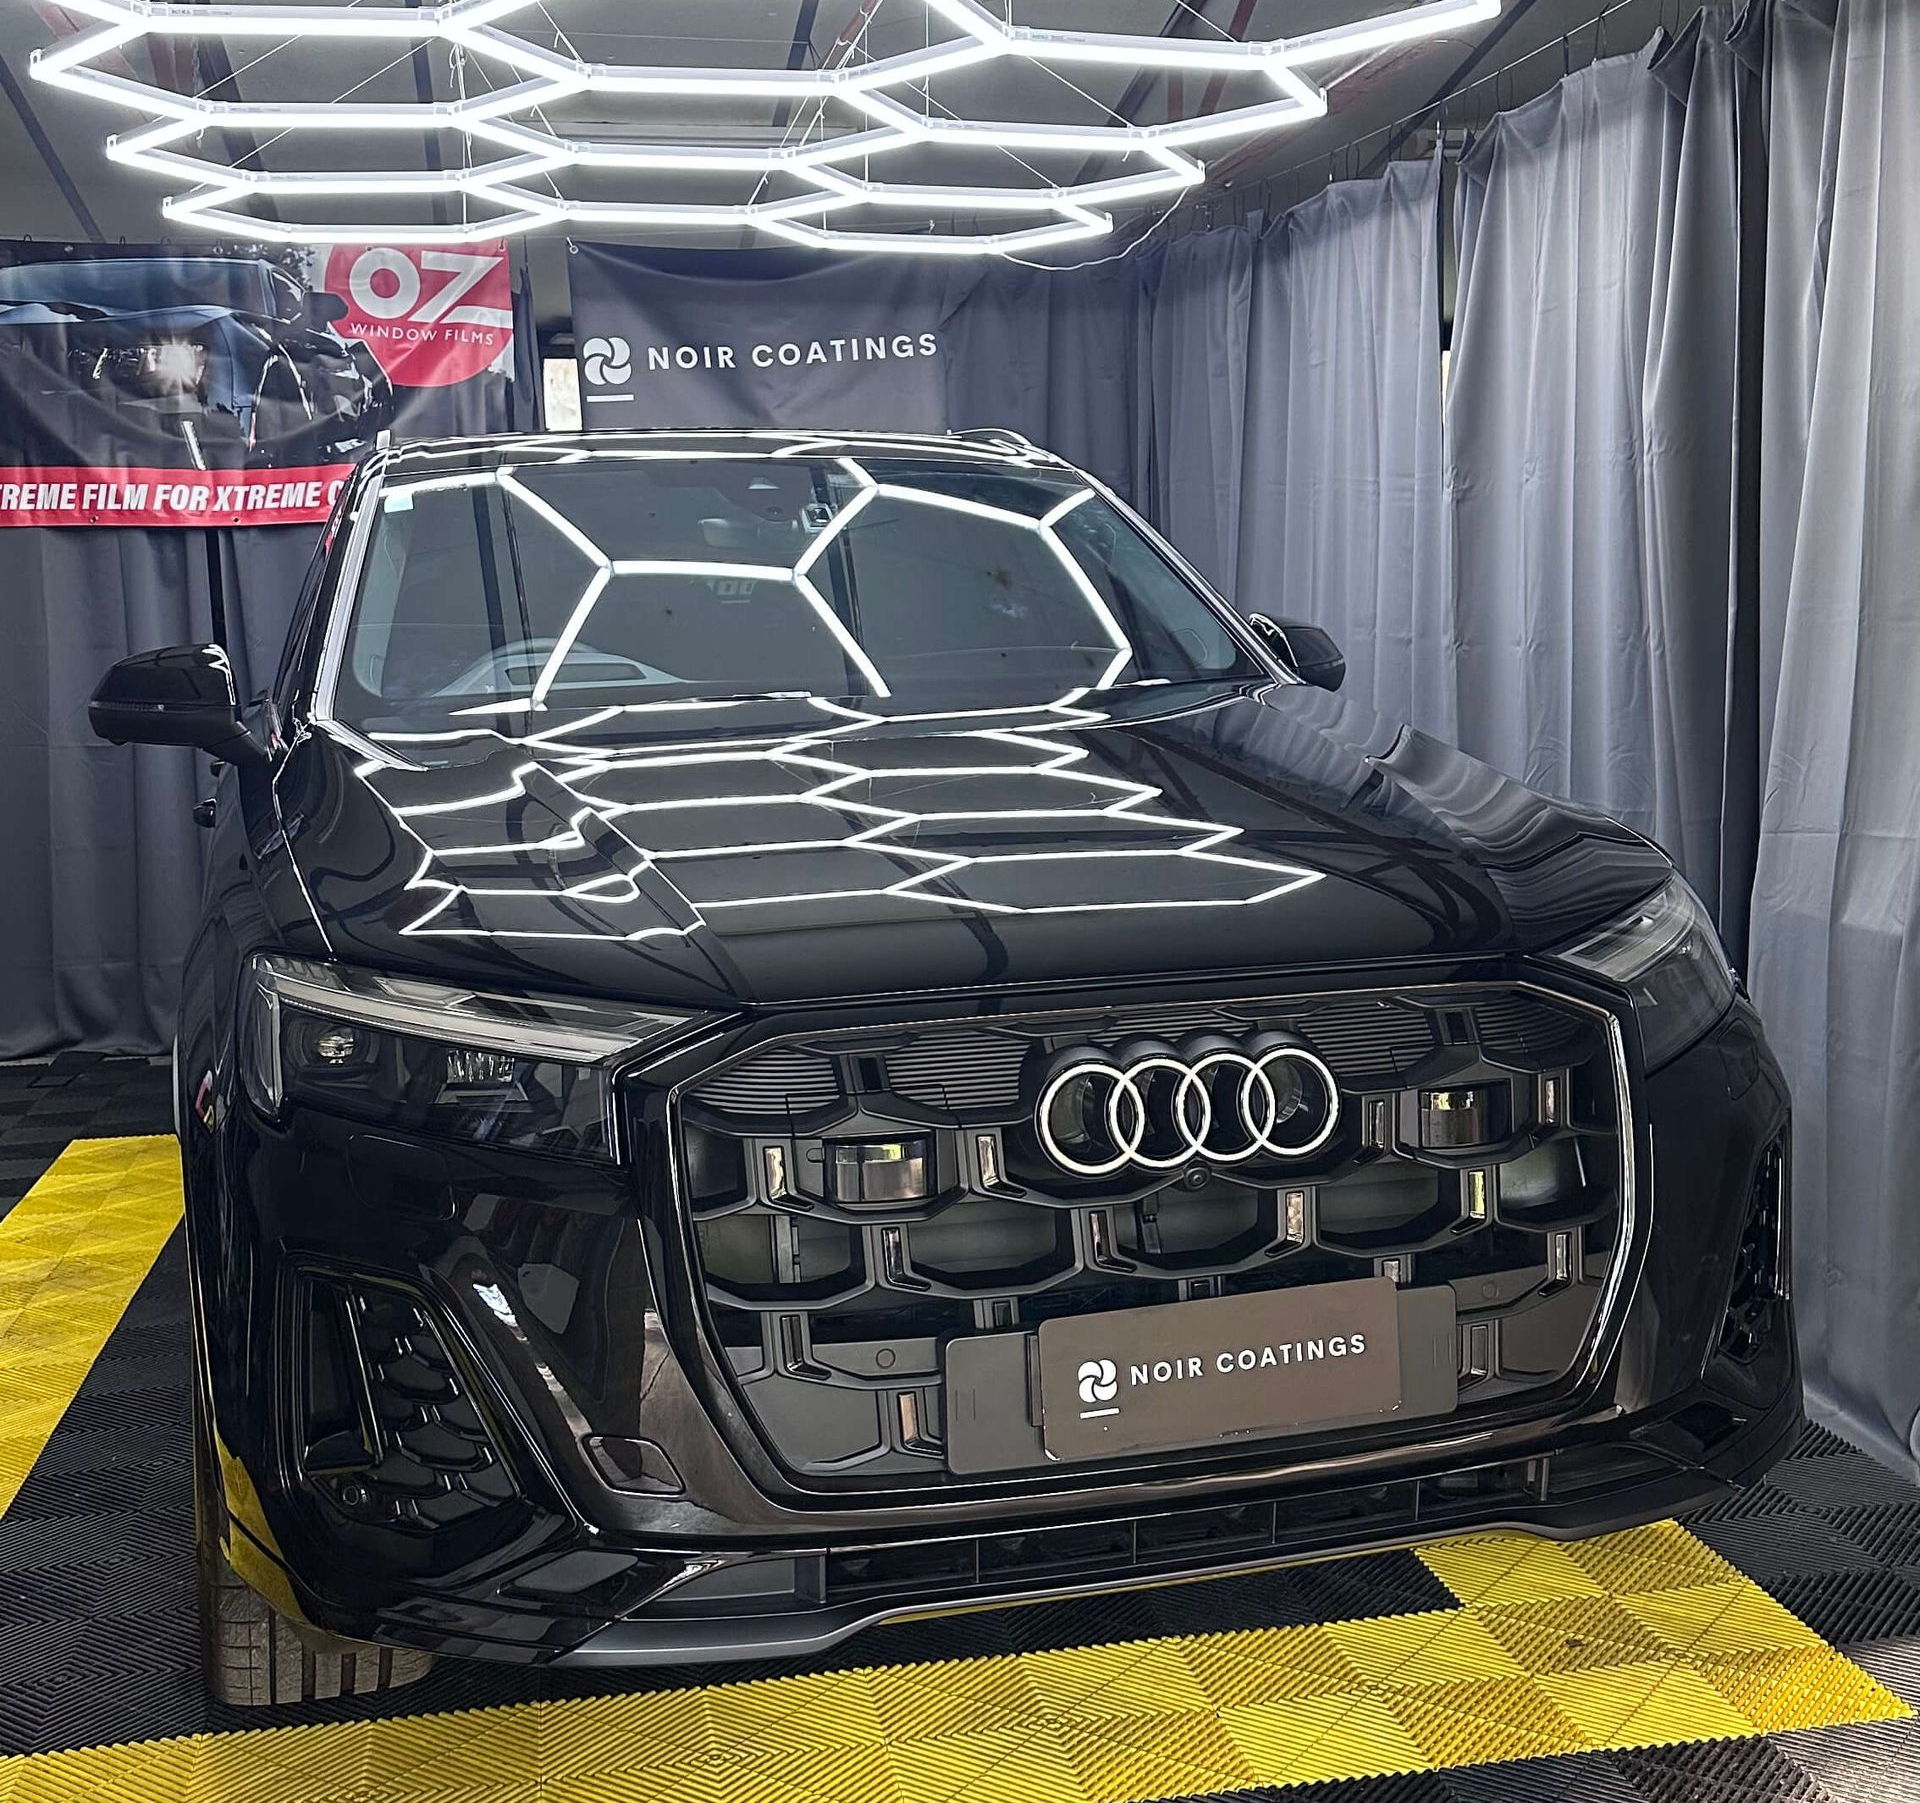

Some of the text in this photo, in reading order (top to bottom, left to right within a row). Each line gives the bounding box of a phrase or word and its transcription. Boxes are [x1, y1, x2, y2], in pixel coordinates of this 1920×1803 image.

[349, 247, 513, 330] OZ
[350, 322, 494, 346] WINDOW FILMS
[647, 333, 937, 371] NOIR COATINGS
[0, 483, 78, 510] REME
[82, 483, 149, 511] FILM
[153, 484, 211, 513] FOR
[212, 481, 323, 513] XTREME
[1130, 1333, 1366, 1386] NOIR COATINGS
